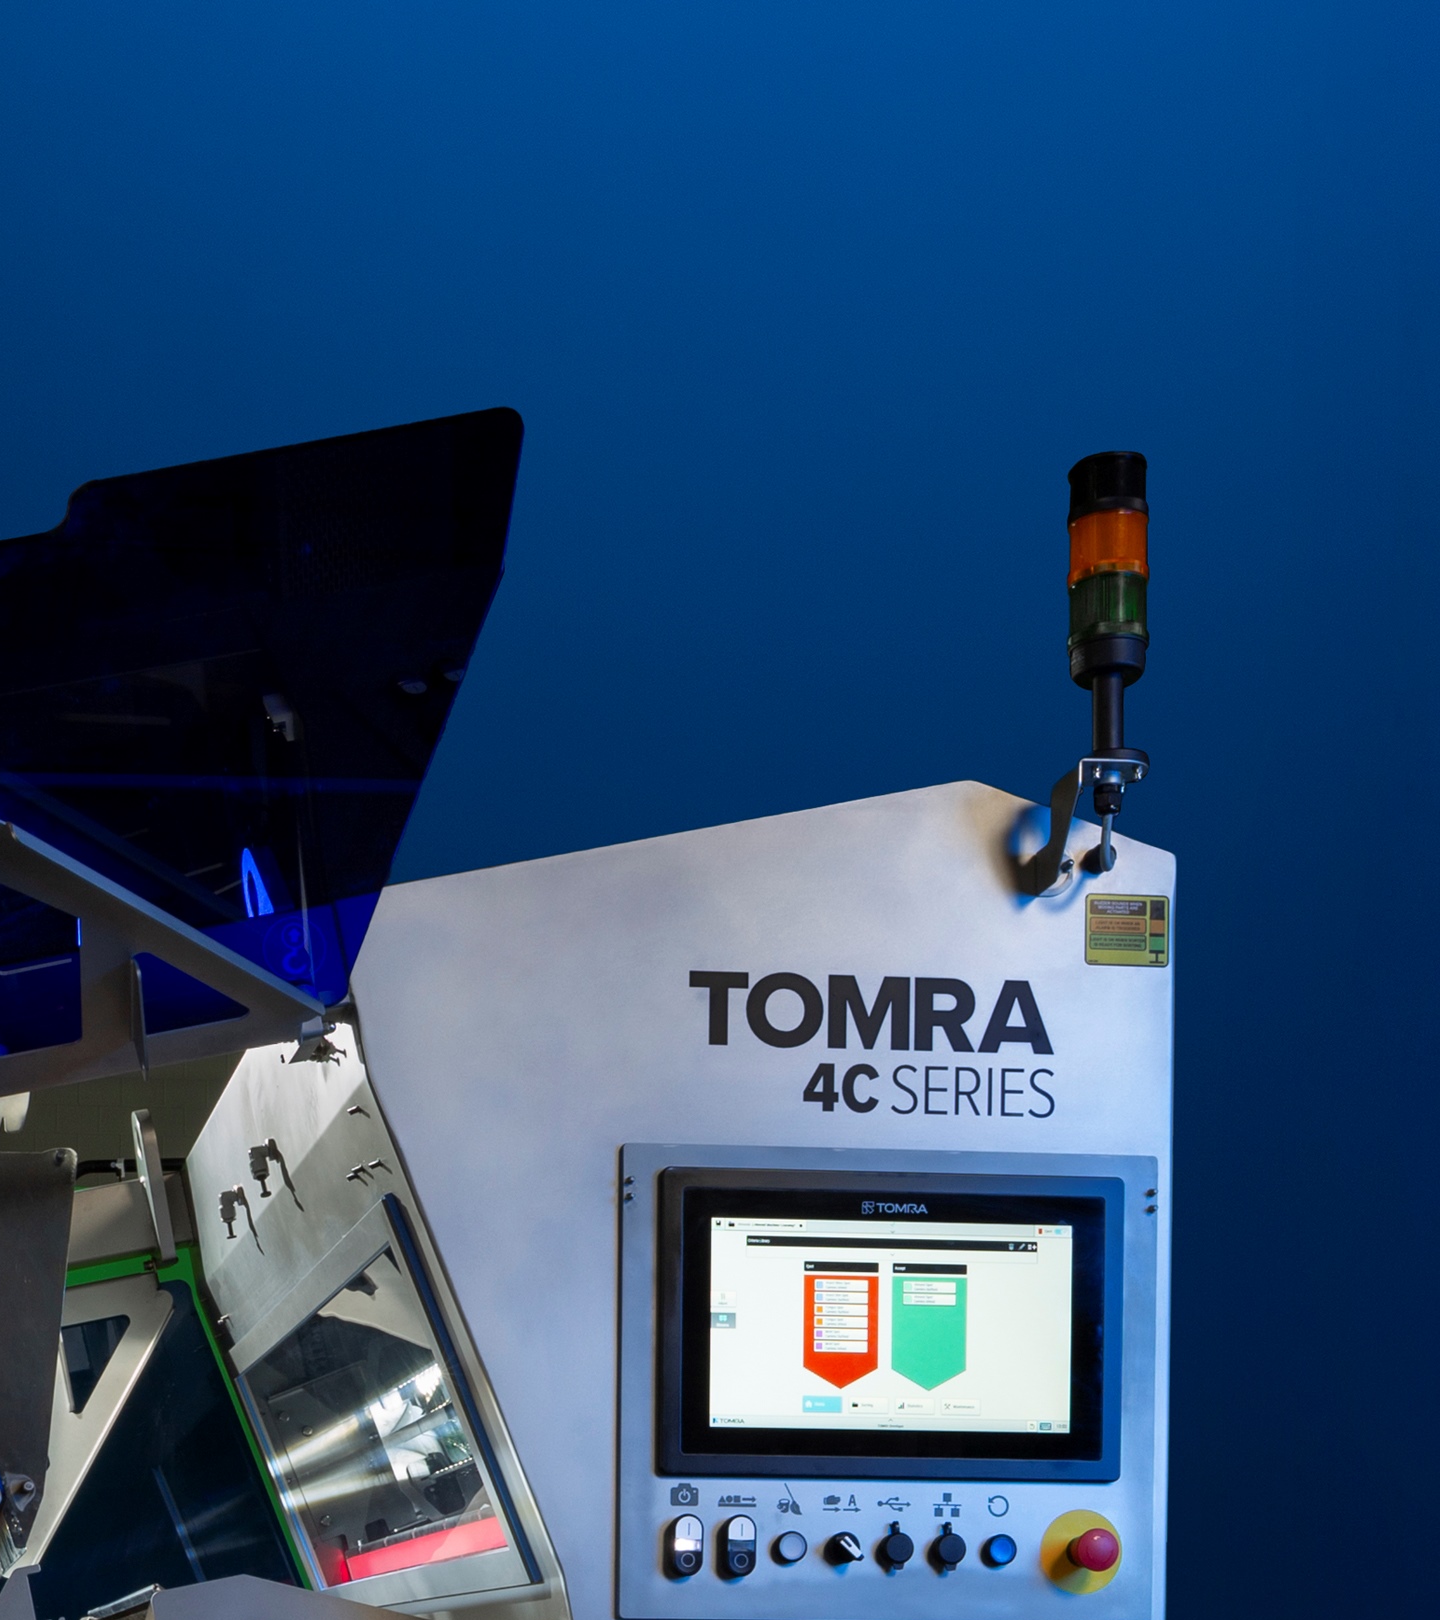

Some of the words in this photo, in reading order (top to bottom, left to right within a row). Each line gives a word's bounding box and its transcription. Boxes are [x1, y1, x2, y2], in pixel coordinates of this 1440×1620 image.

[689, 970, 1054, 1055] TOMRA
[803, 1063, 879, 1114] 4C
[890, 1064, 1055, 1119] SERIES
[876, 1202, 928, 1214] TOMRA
